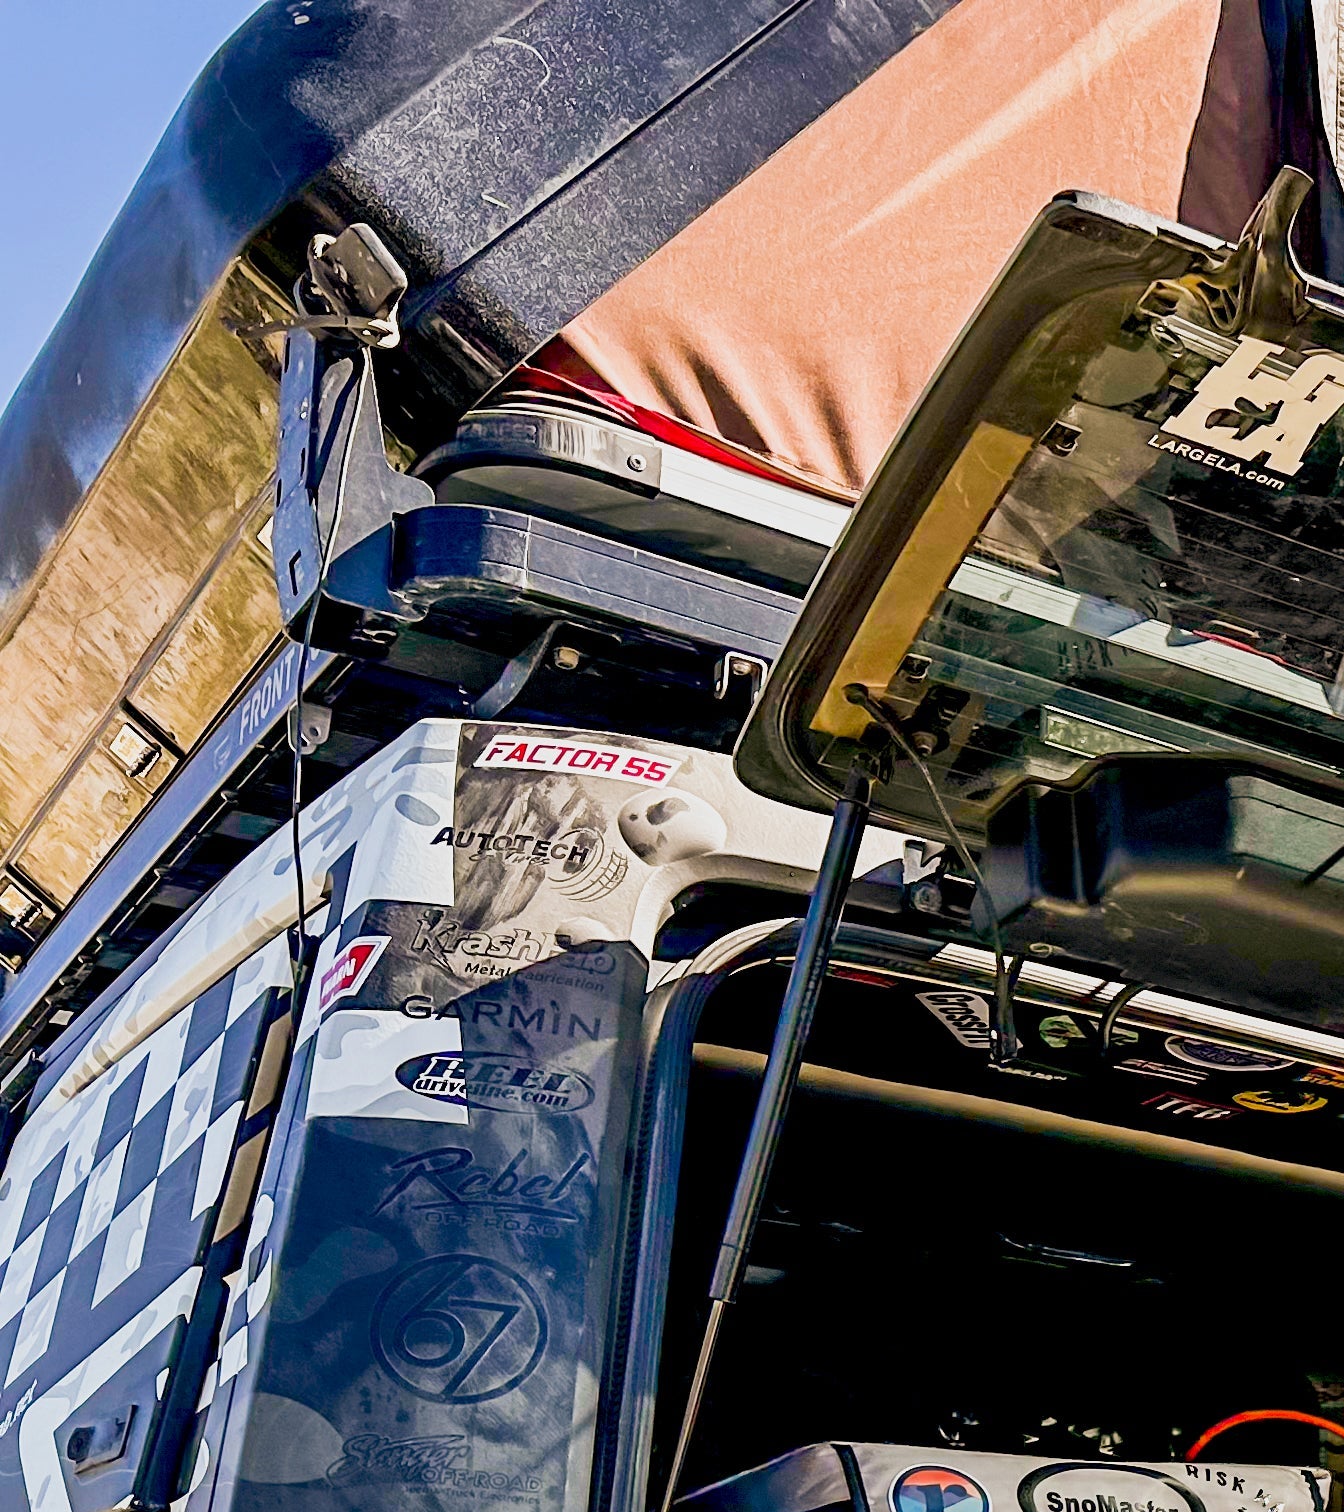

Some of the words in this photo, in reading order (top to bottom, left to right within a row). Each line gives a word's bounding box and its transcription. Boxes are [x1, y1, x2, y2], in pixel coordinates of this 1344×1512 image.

[1147, 434, 1286, 491] LARGELA.com
[239, 646, 297, 746] FRONT
[484, 741, 620, 773] FACTOR
[621, 757, 673, 783] 55
[429, 826, 590, 865] AUTOTECH
[464, 962, 511, 978] Metal
[401, 994, 602, 1042] GARMIN
[418, 1055, 573, 1095] REEL
[369, 1146, 593, 1218] Rebel
[424, 1210, 479, 1228] OFF
[491, 1217, 561, 1240] ROAD
[1184, 1463, 1246, 1495] RISK
